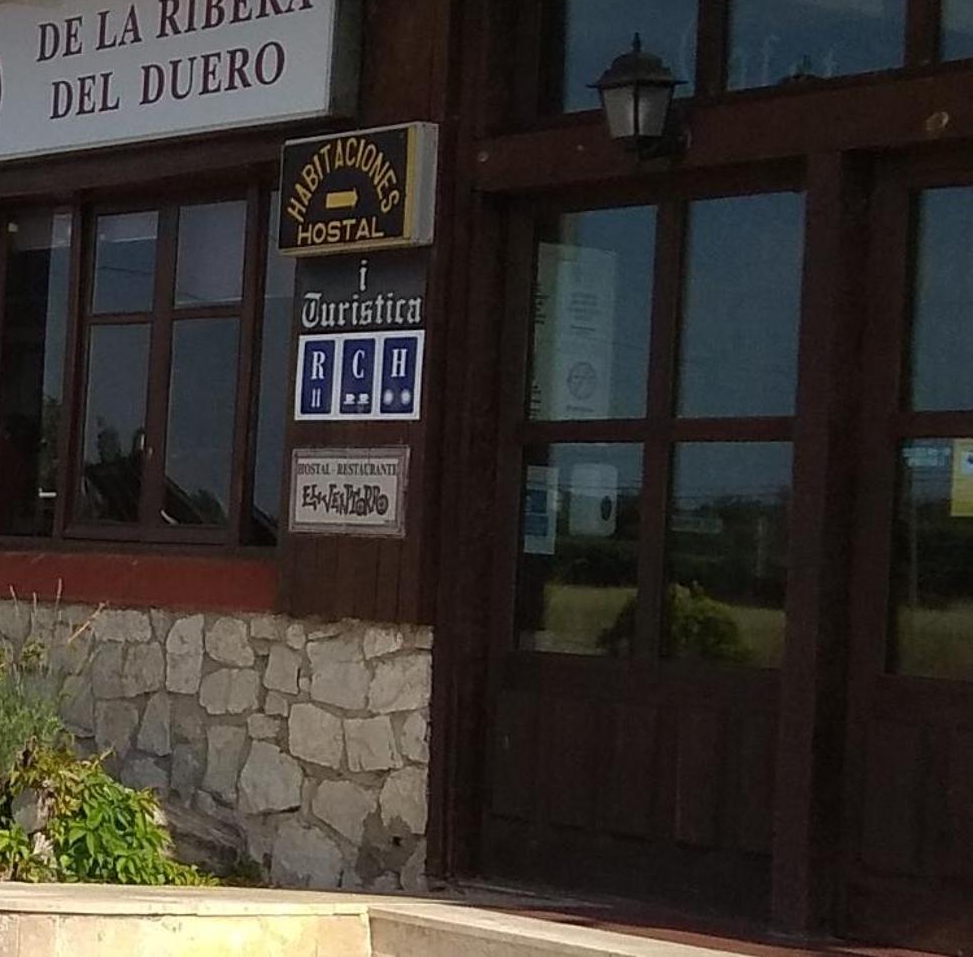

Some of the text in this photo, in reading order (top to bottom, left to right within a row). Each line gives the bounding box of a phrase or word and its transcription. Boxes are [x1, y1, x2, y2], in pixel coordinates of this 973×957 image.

[36, 16, 83, 62] DE
[95, 4, 142, 51] LA
[49, 41, 285, 119] DEL DUERO
[288, 137, 400, 222] HABITACIONES
[297, 216, 384, 245] HOSTAL
[302, 292, 422, 328] Turistica
[311, 351, 326, 380] R
[352, 349, 366, 379] C
[390, 348, 408, 378] H
[297, 464, 330, 475] HOSTAL
